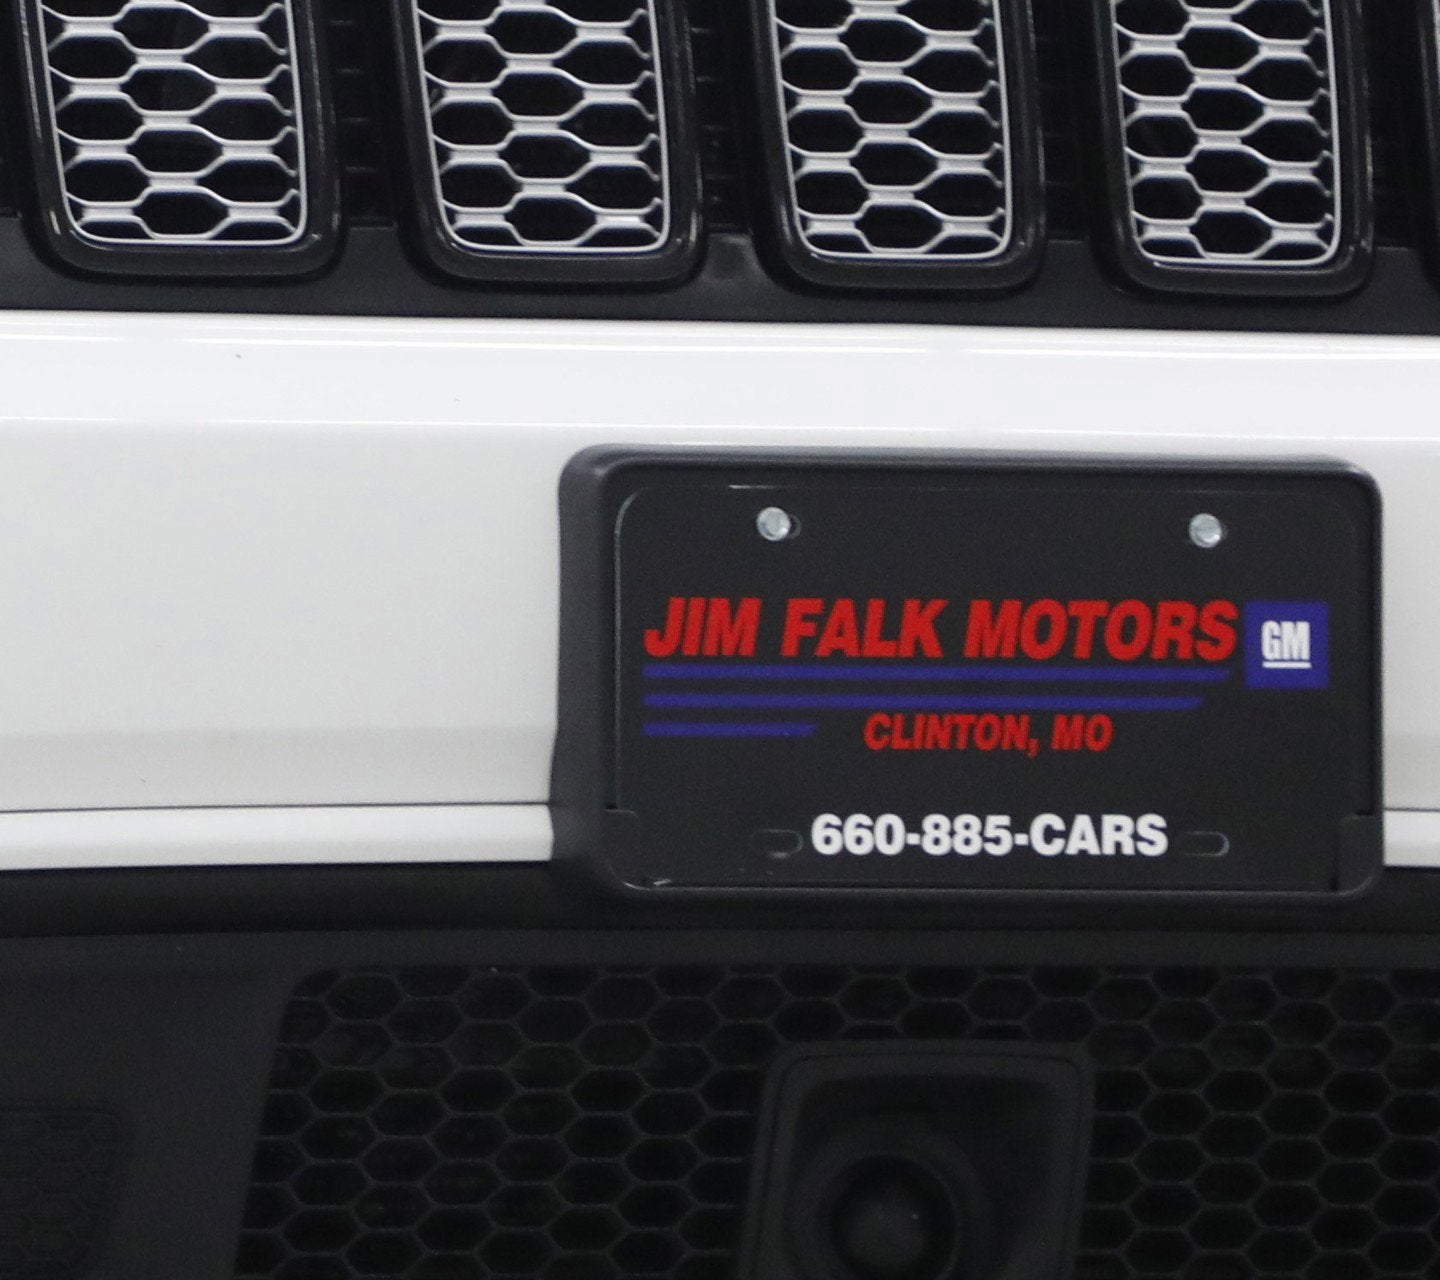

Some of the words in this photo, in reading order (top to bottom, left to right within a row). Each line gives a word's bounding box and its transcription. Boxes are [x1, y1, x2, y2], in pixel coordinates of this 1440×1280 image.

[644, 596, 762, 658] JIM
[781, 597, 949, 658] FALK
[964, 598, 1239, 661] MOTORS
[1261, 620, 1311, 662] GM
[864, 712, 1039, 758] CLINTON,
[1051, 713, 1114, 752] MO
[811, 812, 1169, 858] 660-885-CARS
